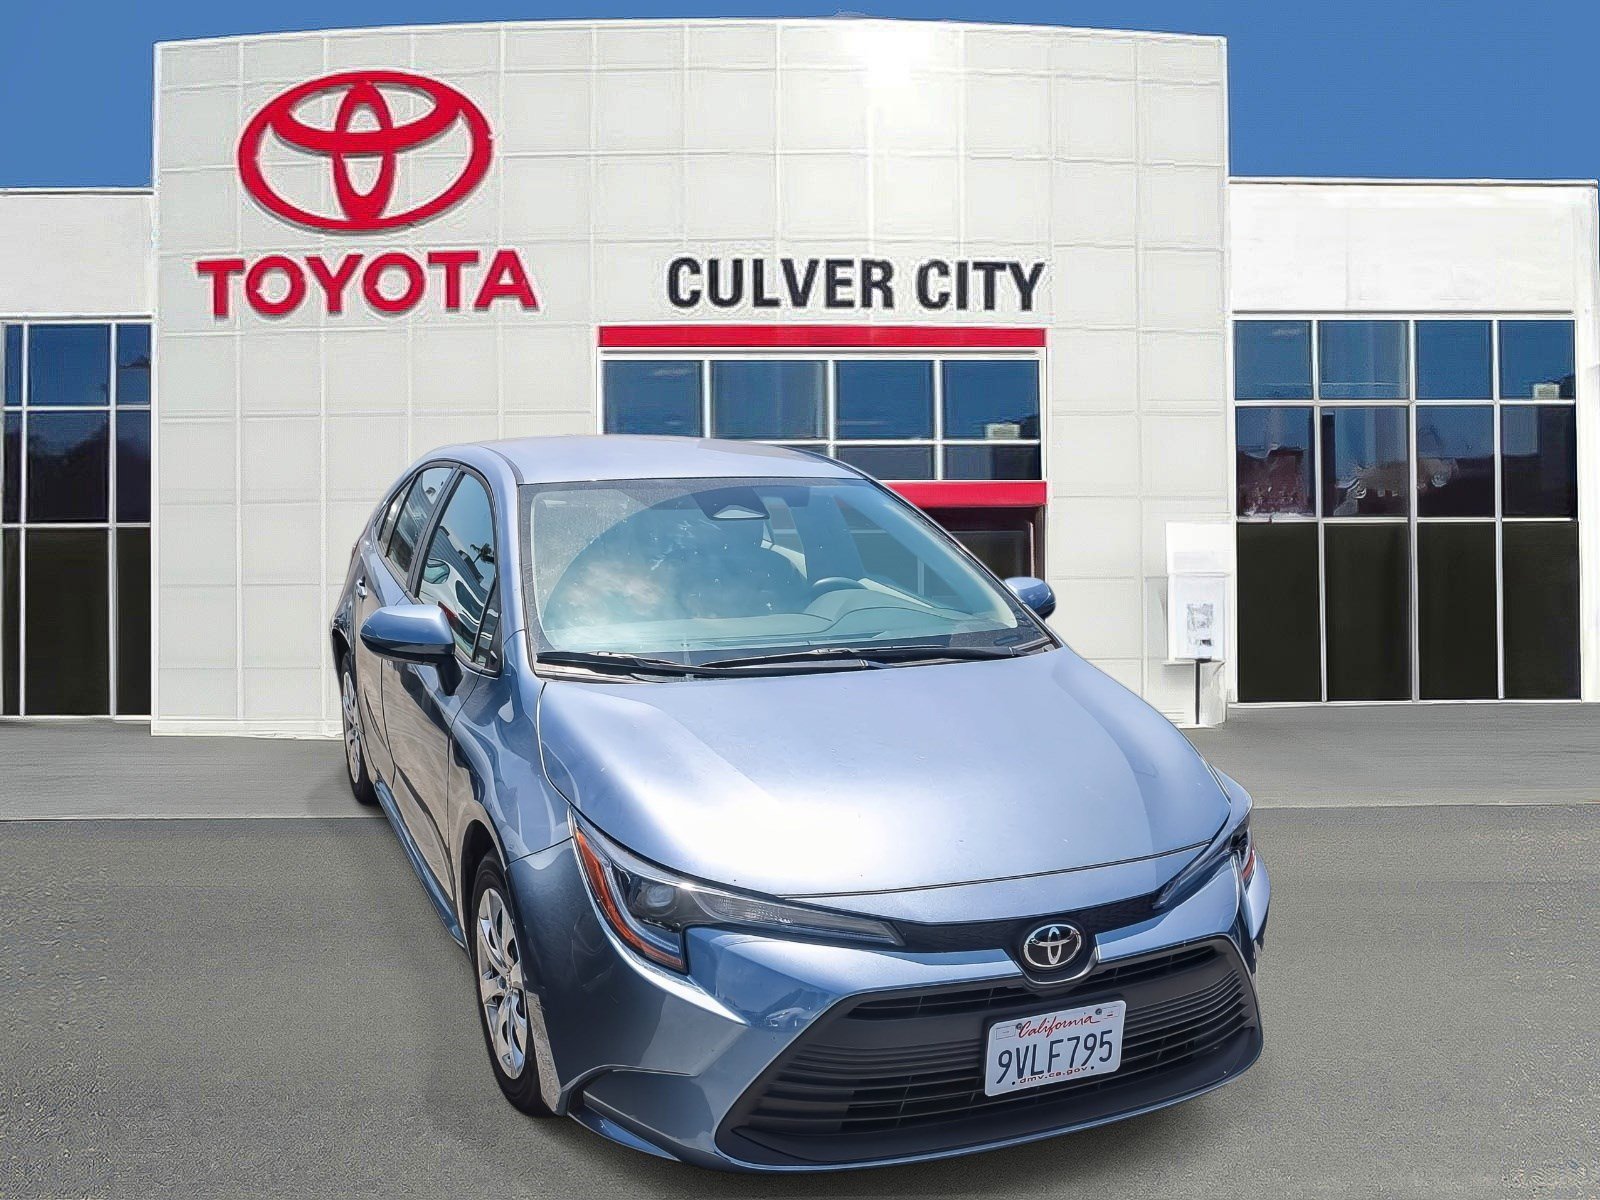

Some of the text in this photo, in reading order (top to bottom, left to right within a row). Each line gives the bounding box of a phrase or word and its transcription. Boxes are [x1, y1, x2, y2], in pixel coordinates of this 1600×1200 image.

[195, 249, 540, 319] TOYOTA
[667, 257, 1046, 311] CULVER CITY
[1018, 1014, 1100, 1038] California
[996, 1030, 1113, 1084] 9VLF795
[1019, 1065, 1088, 1084] dmv.ca.gov
